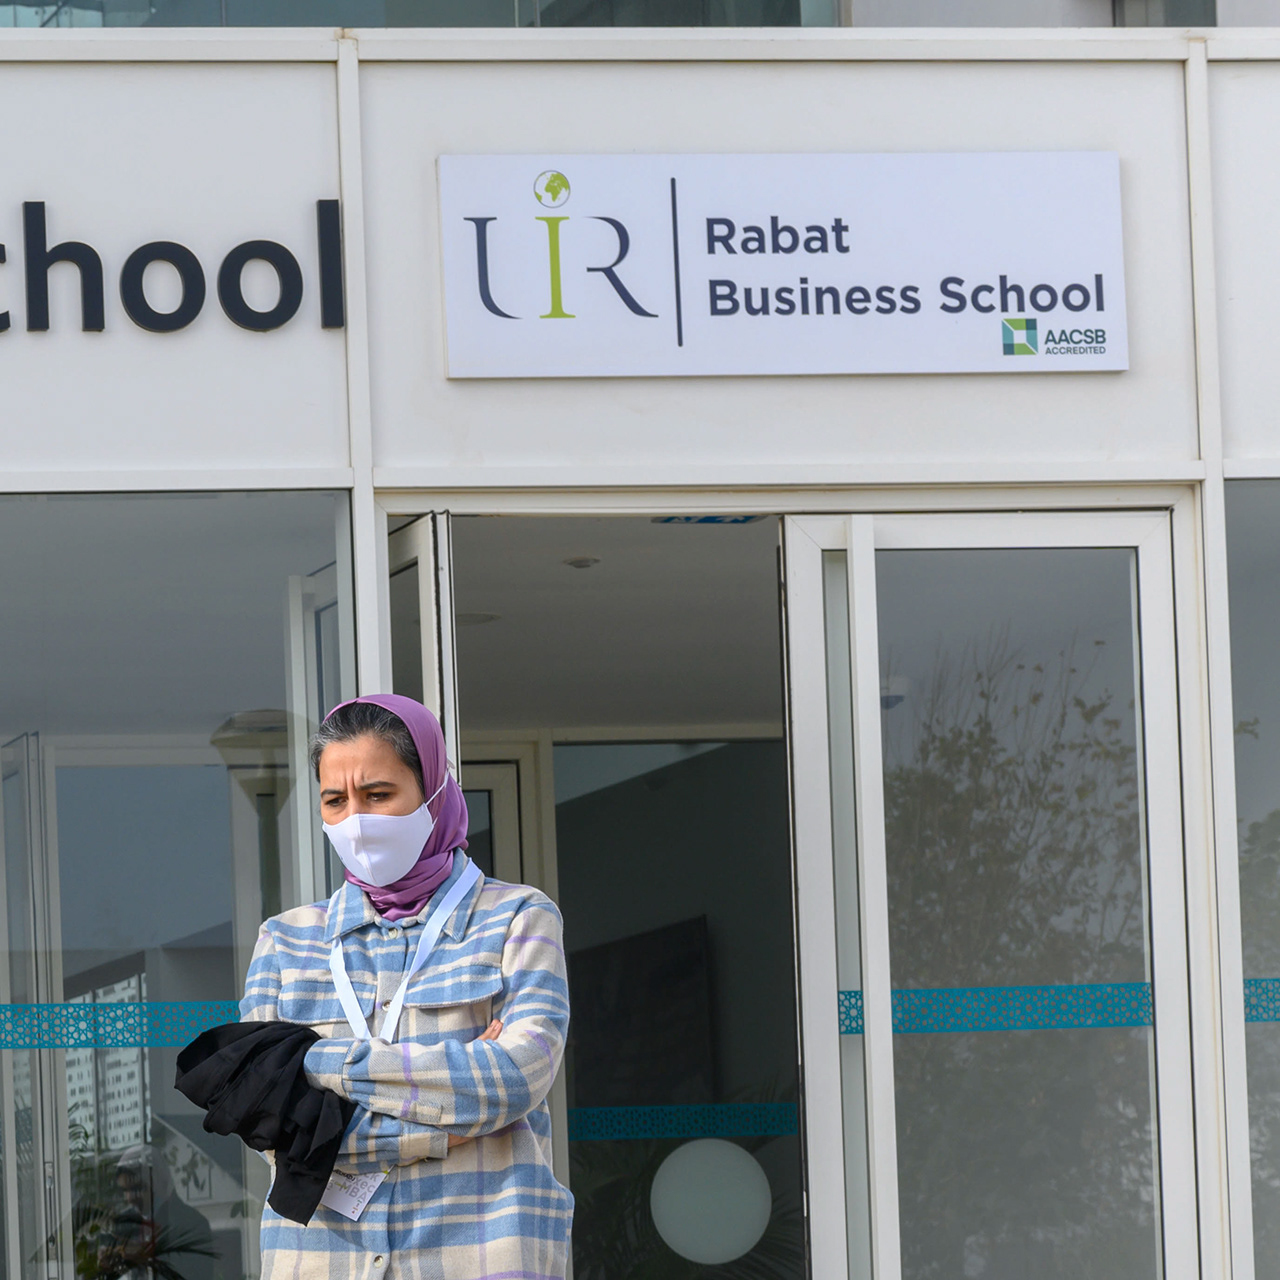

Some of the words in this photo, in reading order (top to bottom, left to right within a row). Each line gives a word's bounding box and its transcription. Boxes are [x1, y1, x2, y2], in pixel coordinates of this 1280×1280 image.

[706, 216, 850, 254] Rabat
[463, 216, 659, 320] UIR
[708, 277, 922, 316] Business
[939, 273, 1105, 313] School
[1044, 329, 1106, 345] AACSB
[1045, 346, 1106, 355] ACCREDITED
